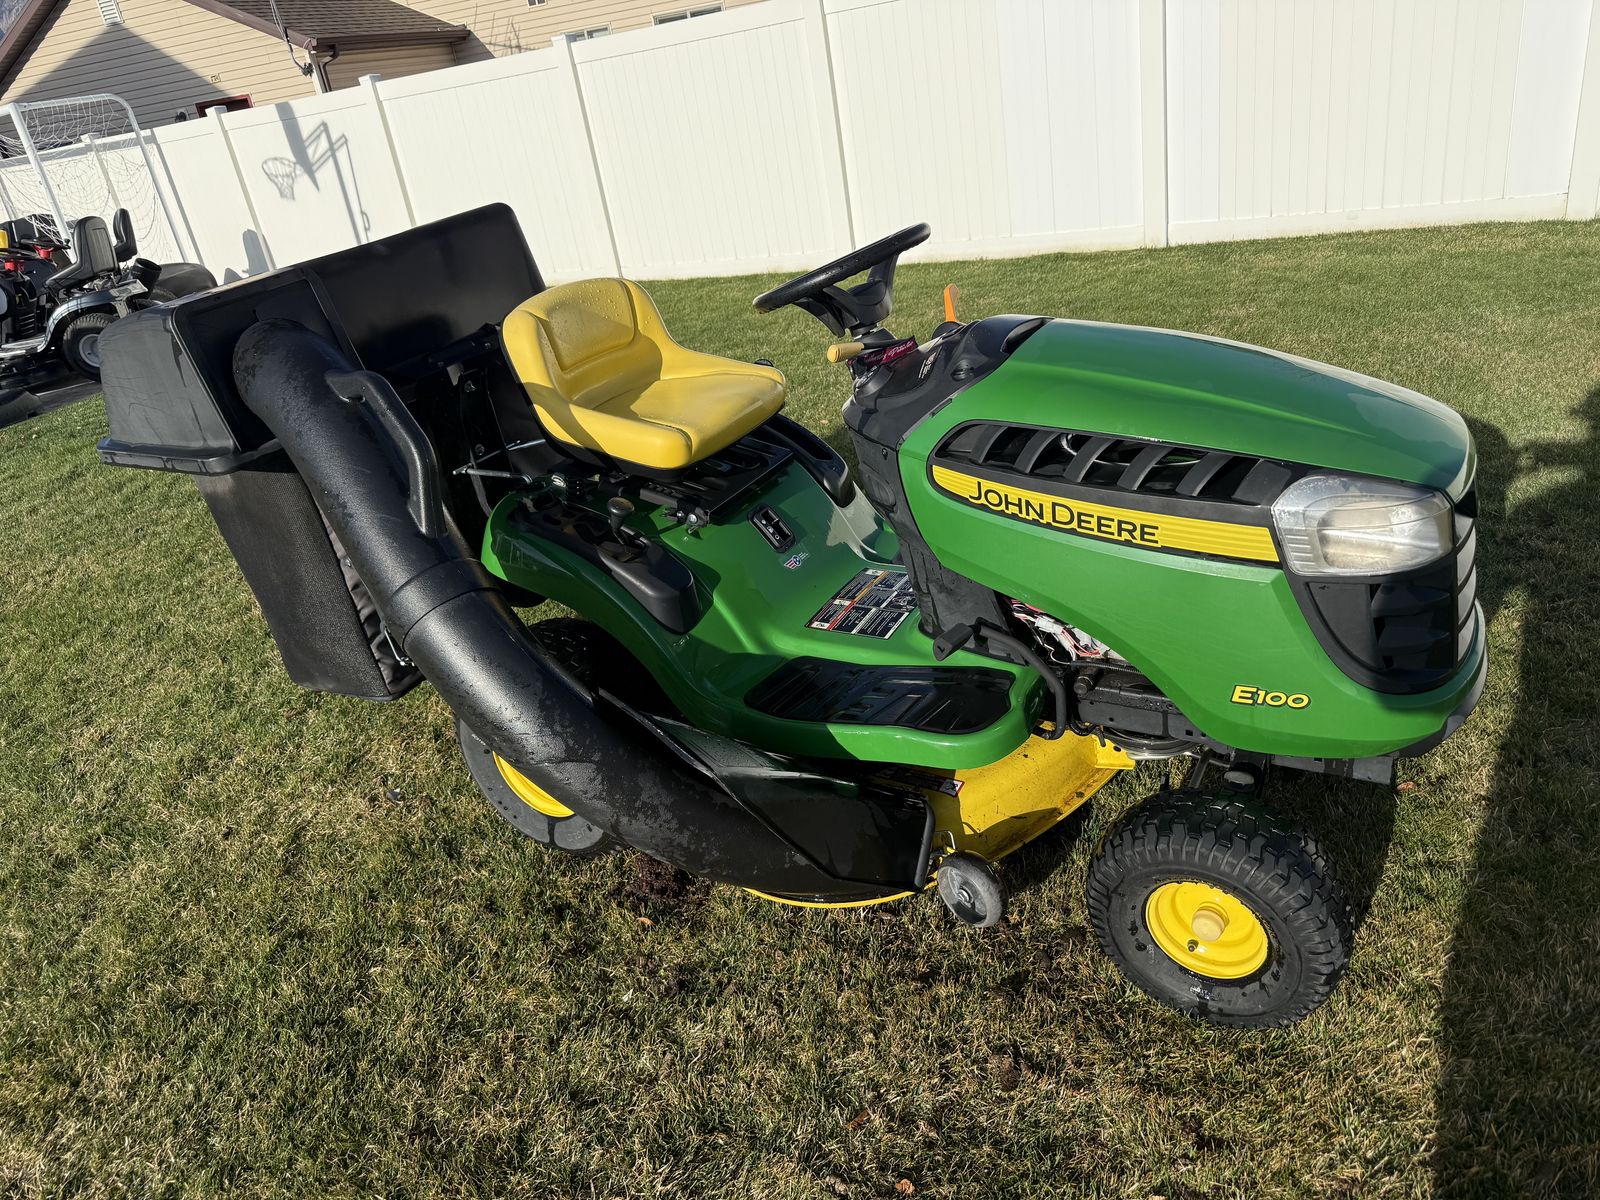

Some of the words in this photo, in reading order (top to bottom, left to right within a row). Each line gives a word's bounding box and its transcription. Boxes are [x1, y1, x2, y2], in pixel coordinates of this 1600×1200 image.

[968, 481, 1044, 521] JOHN
[1051, 501, 1160, 545] DEERE
[1230, 684, 1310, 709] E100
